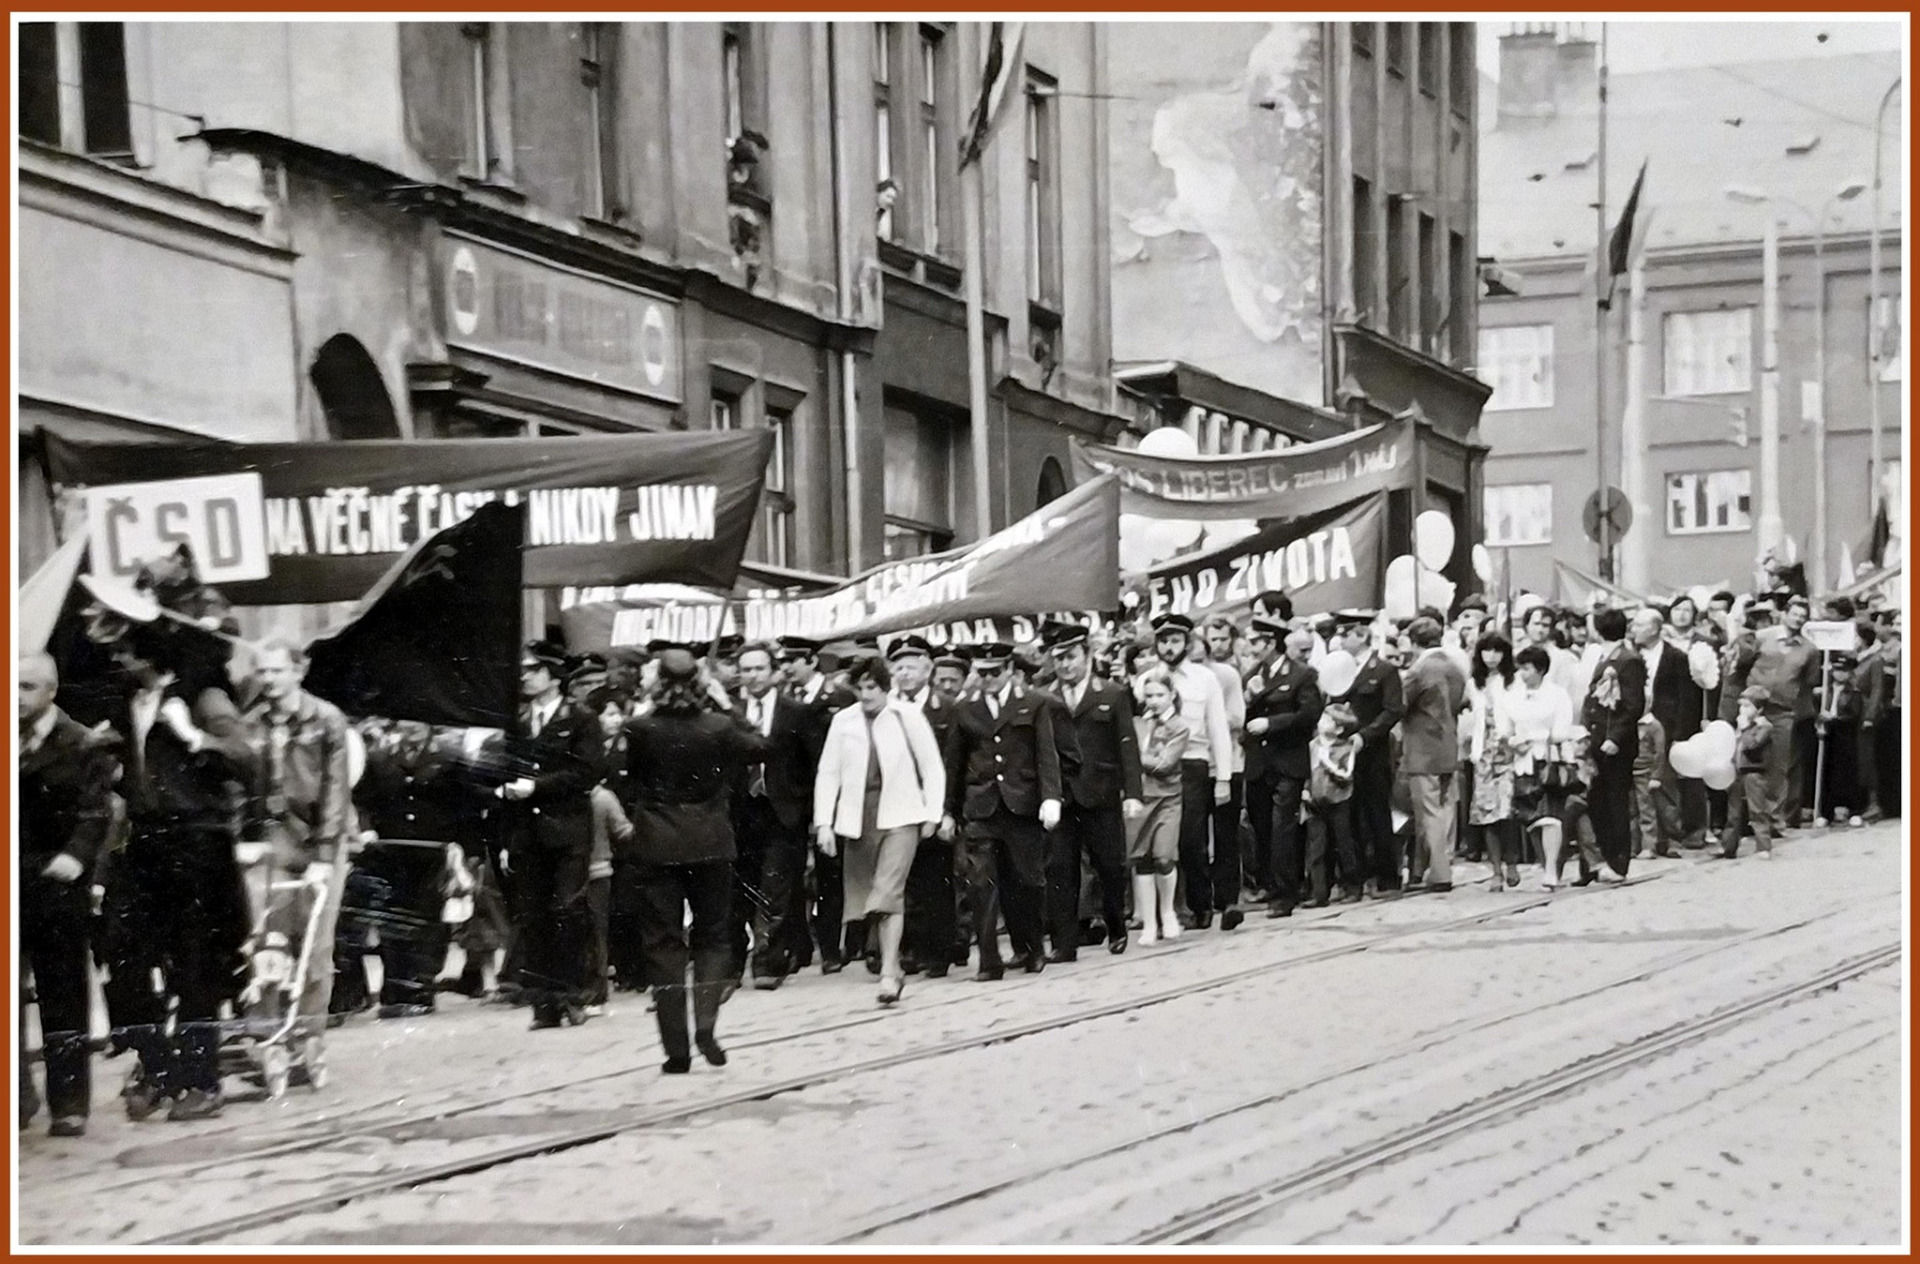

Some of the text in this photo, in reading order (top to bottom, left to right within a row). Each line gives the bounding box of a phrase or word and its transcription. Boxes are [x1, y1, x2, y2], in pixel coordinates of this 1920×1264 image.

[1161, 464, 1289, 501] LIBEREC
[105, 496, 243, 577] ČSD
[265, 483, 719, 555] NA VĚČNÉ ČAS NIKDY JINAK
